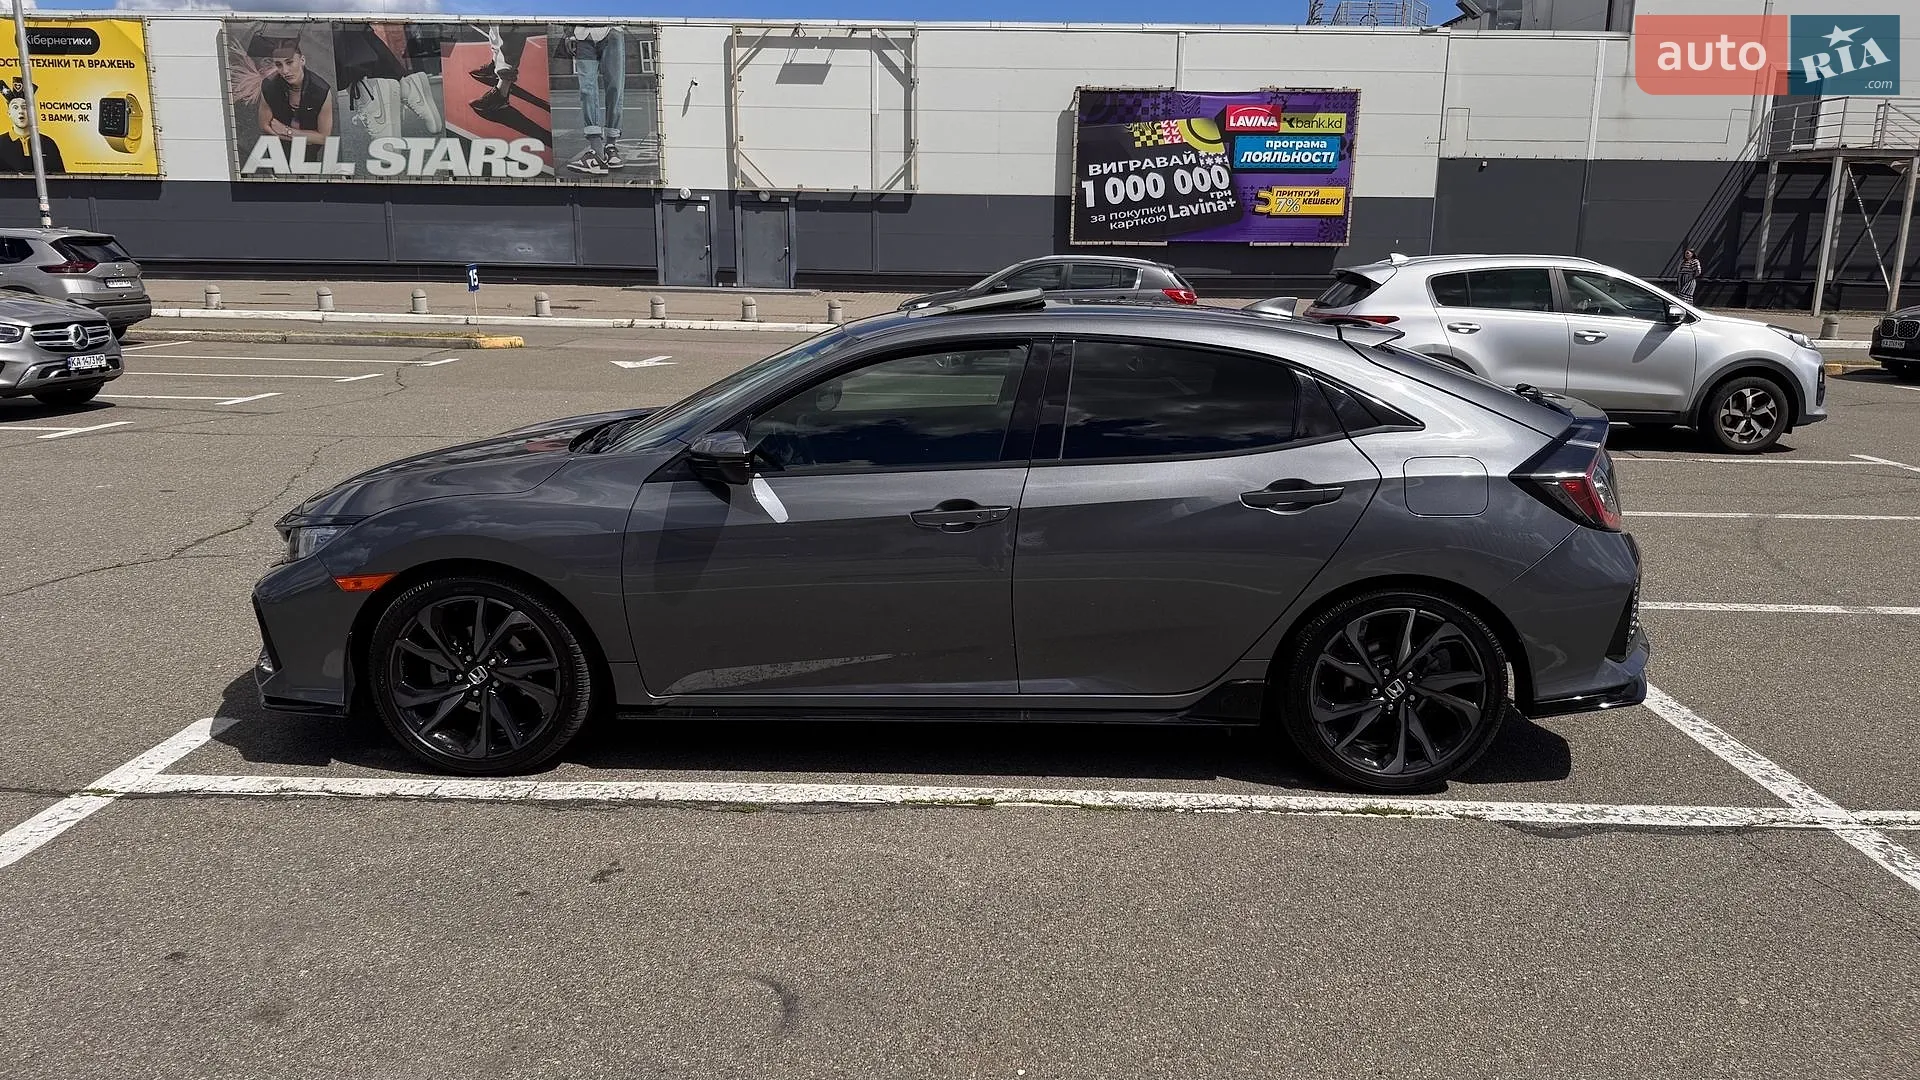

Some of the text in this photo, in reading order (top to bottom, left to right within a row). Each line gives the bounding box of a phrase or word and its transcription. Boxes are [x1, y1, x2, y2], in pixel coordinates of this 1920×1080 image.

[30, 58, 71, 68] ТЕХНІКИ
[73, 59, 86, 68] ТА
[88, 59, 135, 69] ВРАЖЕНЬ
[40, 101, 92, 111] НОСИМОСЯ
[49, 113, 76, 123] ВАМИ,
[78, 114, 90, 122] ЯК
[1229, 115, 1343, 129] LAVINA bank.kd
[1265, 140, 1328, 150] програма
[241, 135, 546, 178] ALL STARS
[1088, 151, 1196, 176] ВИГРАВАЙ
[1240, 151, 1335, 163] ЛОЯЛЬНОСТІ
[1081, 164, 1230, 208] 1 000 000
[1275, 189, 1320, 198] ПРИТЯГУЙ
[1210, 190, 1232, 199] грн
[1167, 197, 1237, 219] Lavina+
[1275, 197, 1342, 213] 7% КЕШБЕКУ
[1090, 205, 1166, 223] за покупки
[1110, 214, 1167, 230] карткою
[469, 269, 479, 287] 15
